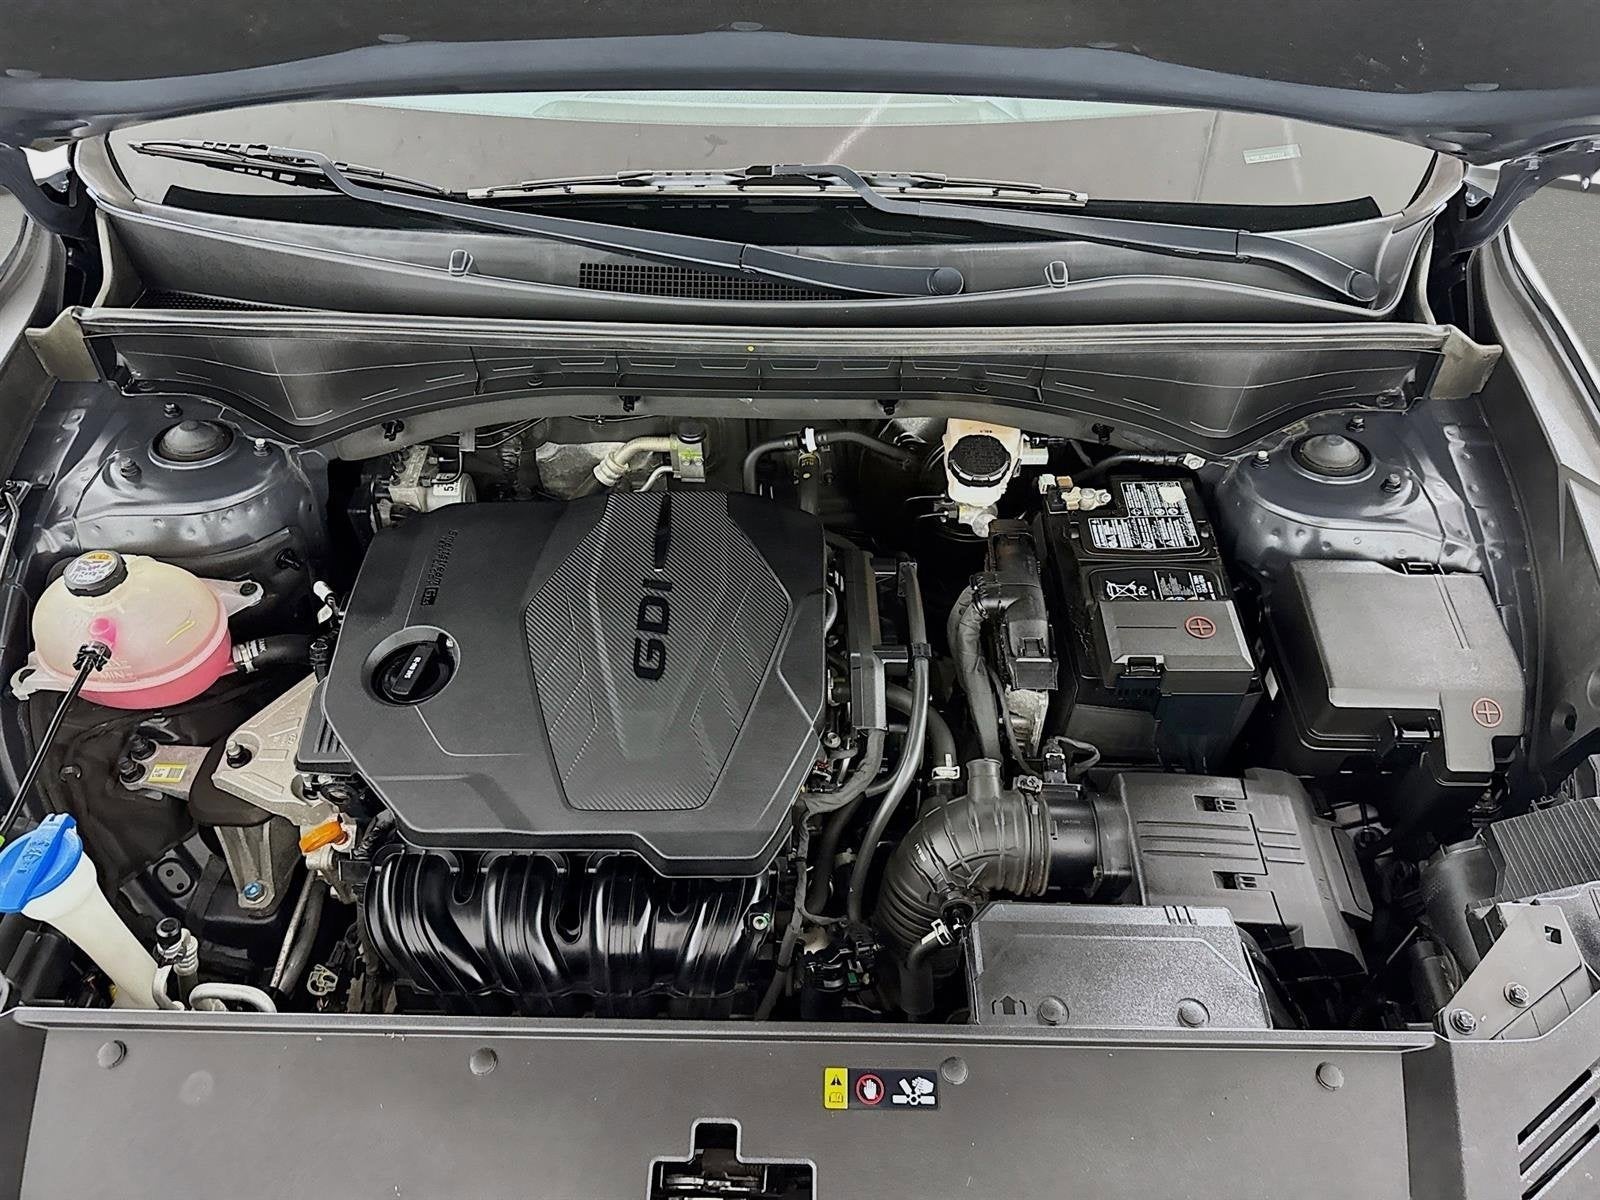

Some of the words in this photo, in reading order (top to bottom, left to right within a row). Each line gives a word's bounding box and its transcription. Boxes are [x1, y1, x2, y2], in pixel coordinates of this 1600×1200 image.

[434, 530, 458, 586] Smartstream
[1138, 585, 1148, 596] Pb
[633, 578, 673, 682] GDI
